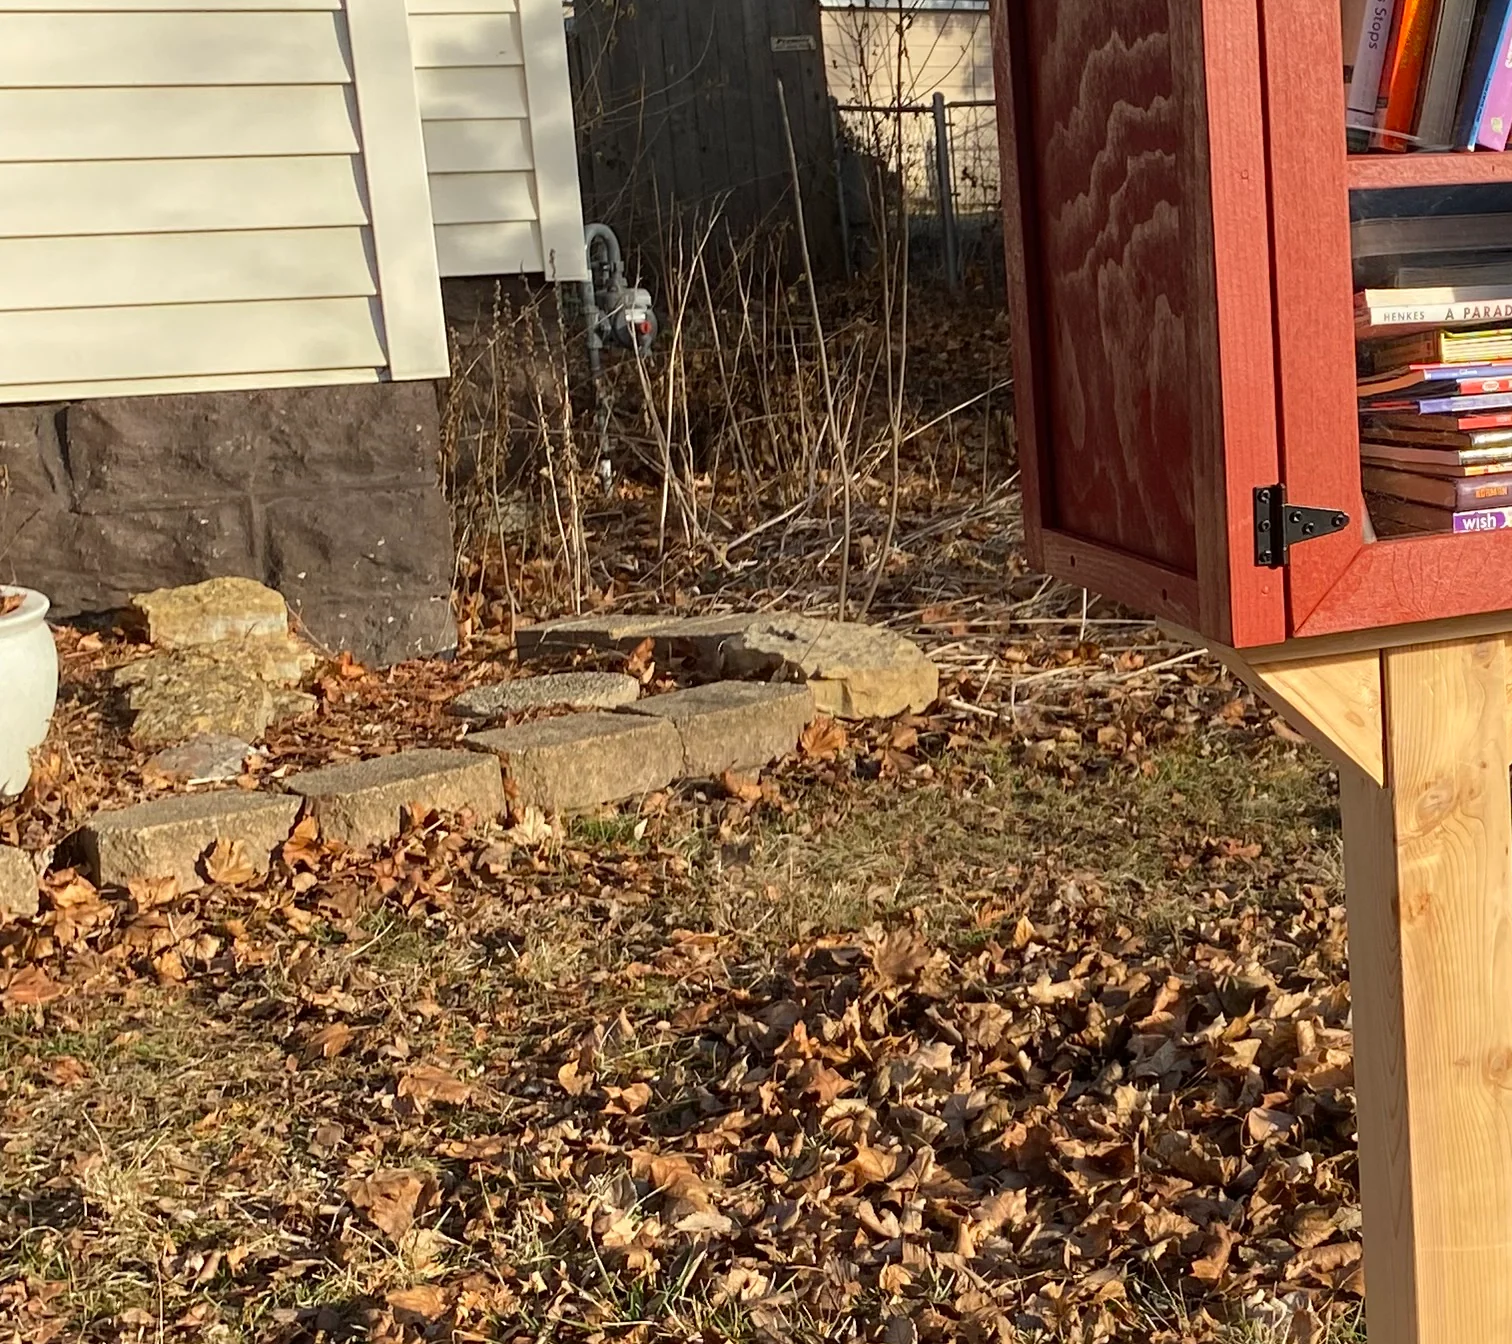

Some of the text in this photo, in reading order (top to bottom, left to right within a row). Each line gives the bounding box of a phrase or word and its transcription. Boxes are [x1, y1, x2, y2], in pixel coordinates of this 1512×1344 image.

[1368, 7, 1387, 49] Stops
[1383, 311, 1425, 322] HENKES
[1445, 308, 1455, 320] A
[1462, 514, 1497, 530] wish
